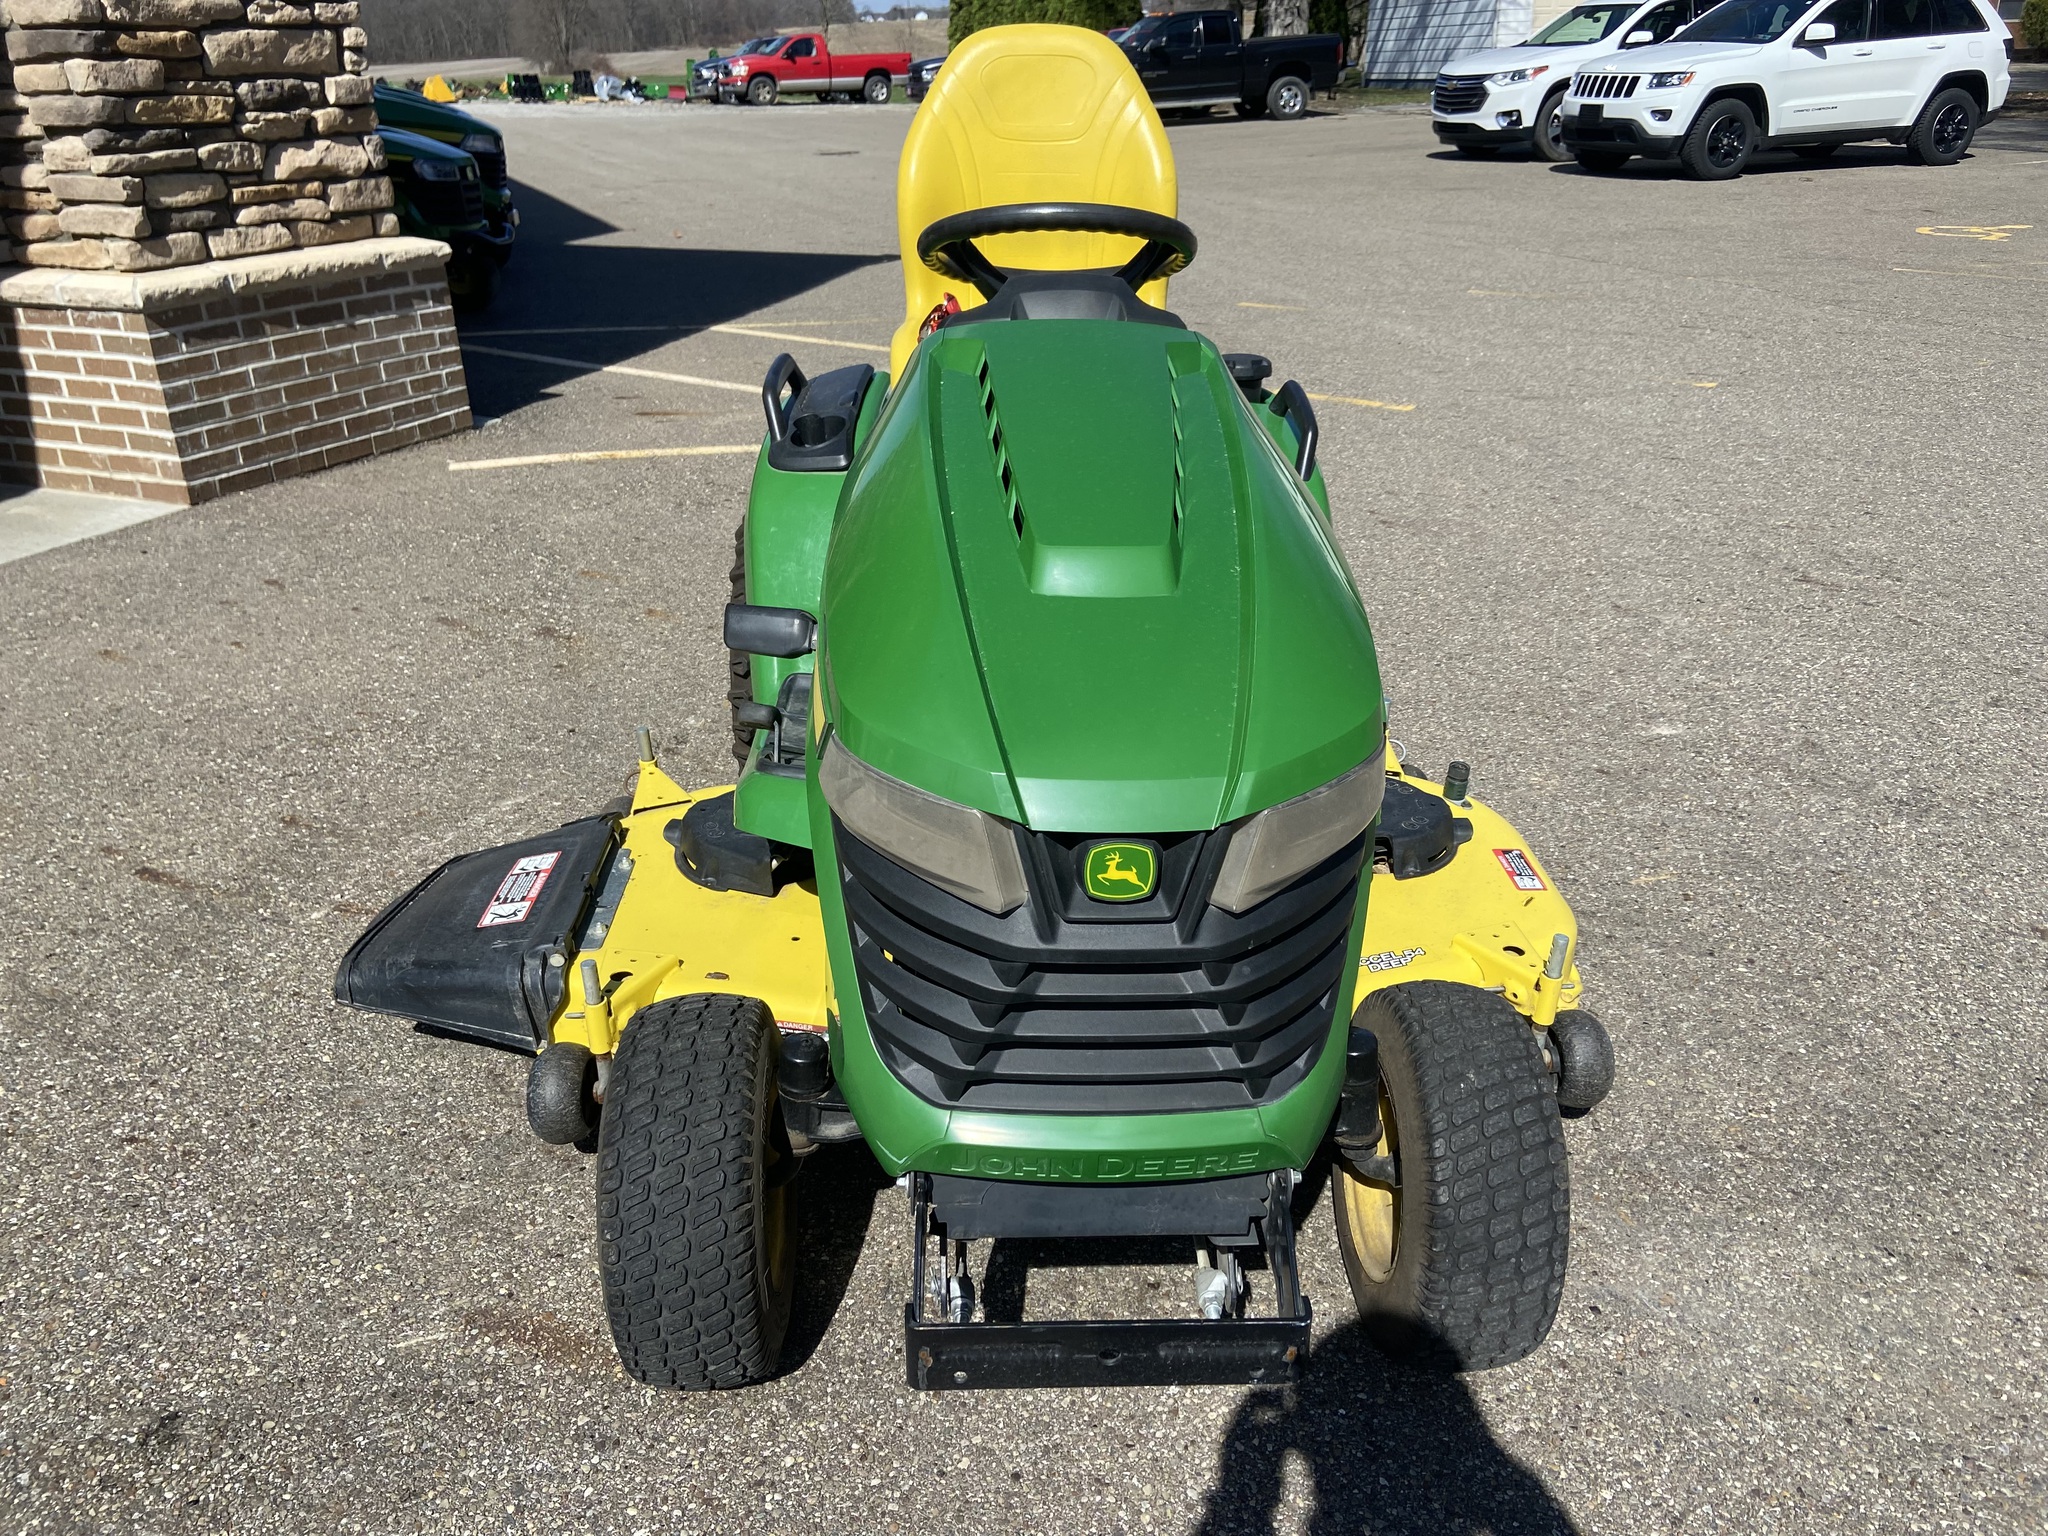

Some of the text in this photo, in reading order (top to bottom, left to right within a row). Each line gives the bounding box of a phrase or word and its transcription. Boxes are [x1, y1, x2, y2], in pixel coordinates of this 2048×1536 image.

[1359, 947, 1426, 966] CCEL 54
[1368, 956, 1413, 973] DEEP
[783, 1021, 813, 1031] DANGER
[950, 1149, 1260, 1179] JOHN DEERE
